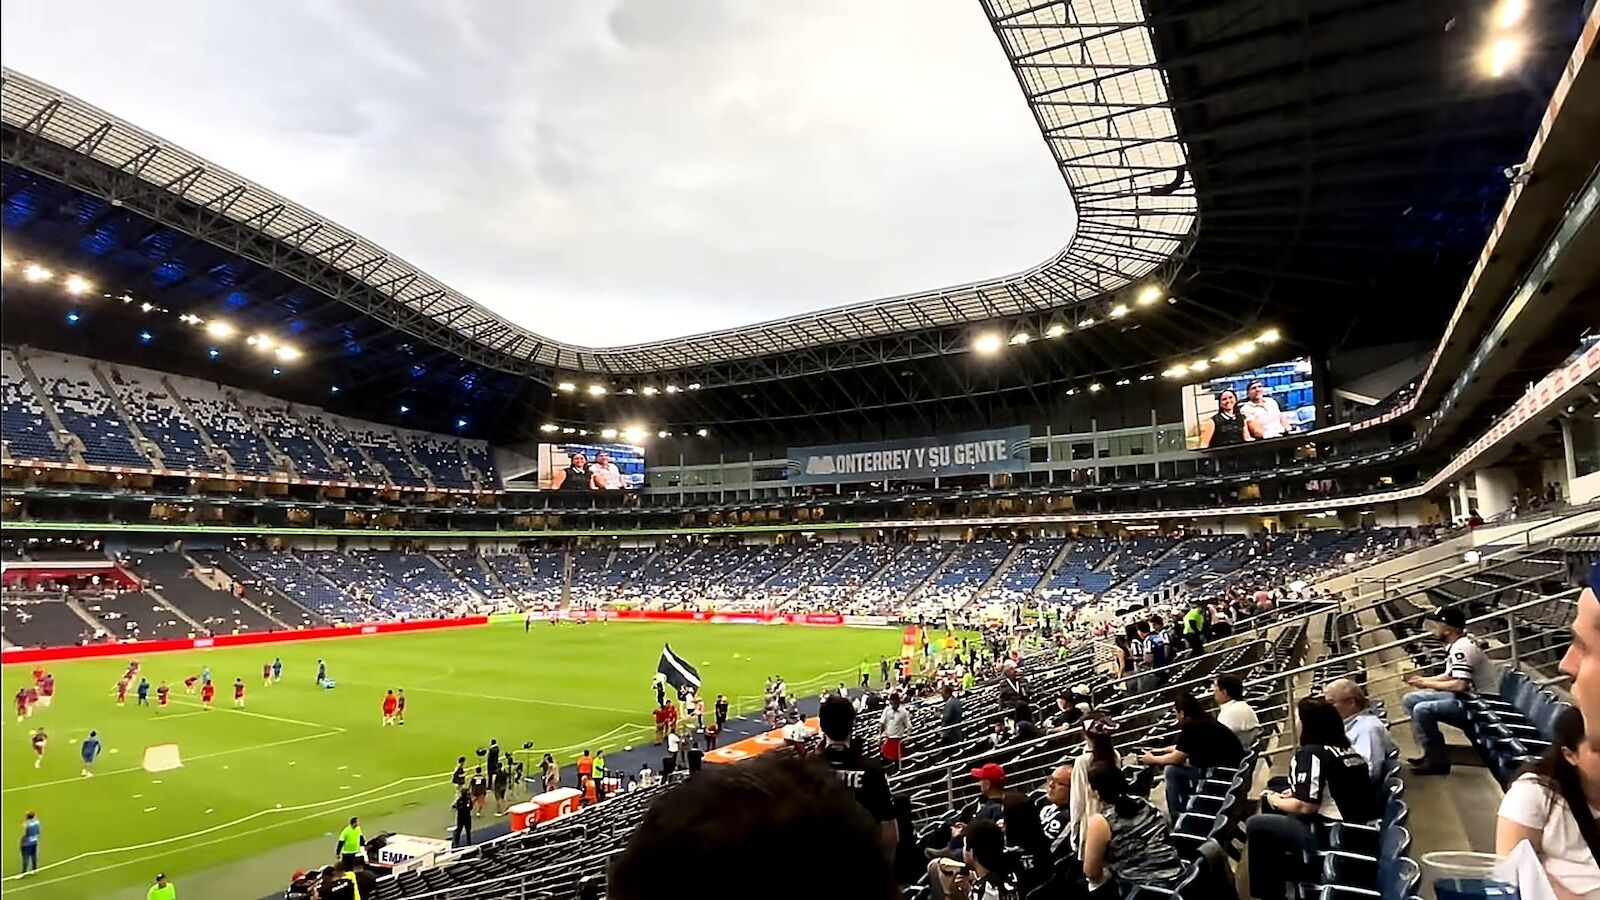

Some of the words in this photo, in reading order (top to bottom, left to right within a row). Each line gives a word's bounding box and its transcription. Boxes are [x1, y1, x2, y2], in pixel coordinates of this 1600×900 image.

[806, 449, 911, 474] MONTERREY
[914, 447, 925, 468] Y
[928, 446, 951, 467] SU
[954, 439, 1008, 465] GENTE
